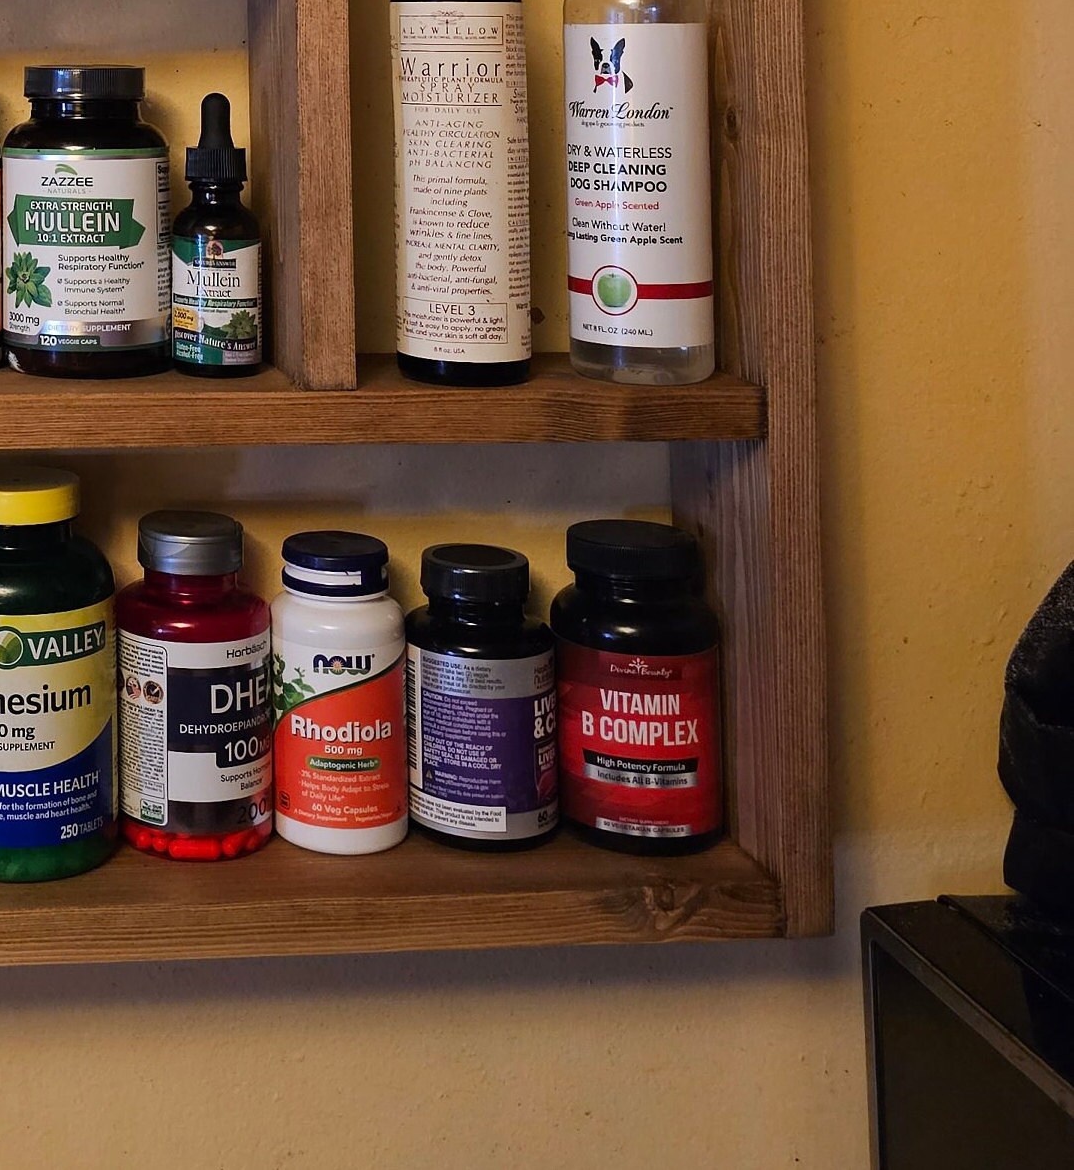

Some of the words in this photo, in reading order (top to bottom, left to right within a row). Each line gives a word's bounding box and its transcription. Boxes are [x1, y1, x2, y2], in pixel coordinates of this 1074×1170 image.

[401, 57, 501, 77] Warrior
[420, 83, 475, 92] SPRAY
[402, 92, 498, 103] MOISTURIZER
[568, 100, 612, 120] Warren
[612, 101, 669, 120] London
[584, 147, 592, 158] &
[594, 146, 672, 158] WATERLESS
[568, 161, 590, 172] DEEP
[593, 162, 666, 176] CLEANING
[41, 177, 93, 187] ZAZZEE
[570, 178, 590, 190] DOG
[593, 180, 667, 193] SHAMPOO
[31, 201, 58, 211] EXTRA
[61, 202, 113, 210] STRENGTH
[25, 211, 120, 232] MULLEIN
[572, 218, 589, 229] Clean
[592, 220, 626, 231] Without
[628, 222, 666, 232] Water!
[37, 233, 58, 243] 10:1
[61, 233, 105, 243] EXTRACT
[58, 254, 96, 262] Supports
[98, 253, 130, 262] Healthy
[58, 262, 106, 271] Respiratory
[187, 270, 240, 288] Mullein
[197, 287, 231, 297] Extract
[429, 303, 463, 315] LEVEL
[468, 306, 476, 316] 3
[27, 626, 104, 660] VALLEY
[210, 674, 271, 714] DHE
[600, 688, 680, 715] VITAMIN
[11, 725, 35, 740] mg
[291, 714, 392, 743] Rhodiola
[582, 711, 594, 736] B
[599, 718, 698, 746] COMPLEX
[225, 736, 259, 761] 100
[325, 745, 343, 754] 500
[347, 747, 363, 756] mg
[597, 756, 615, 767] High
[617, 760, 650, 772] Potency
[653, 763, 685, 772] Formula
